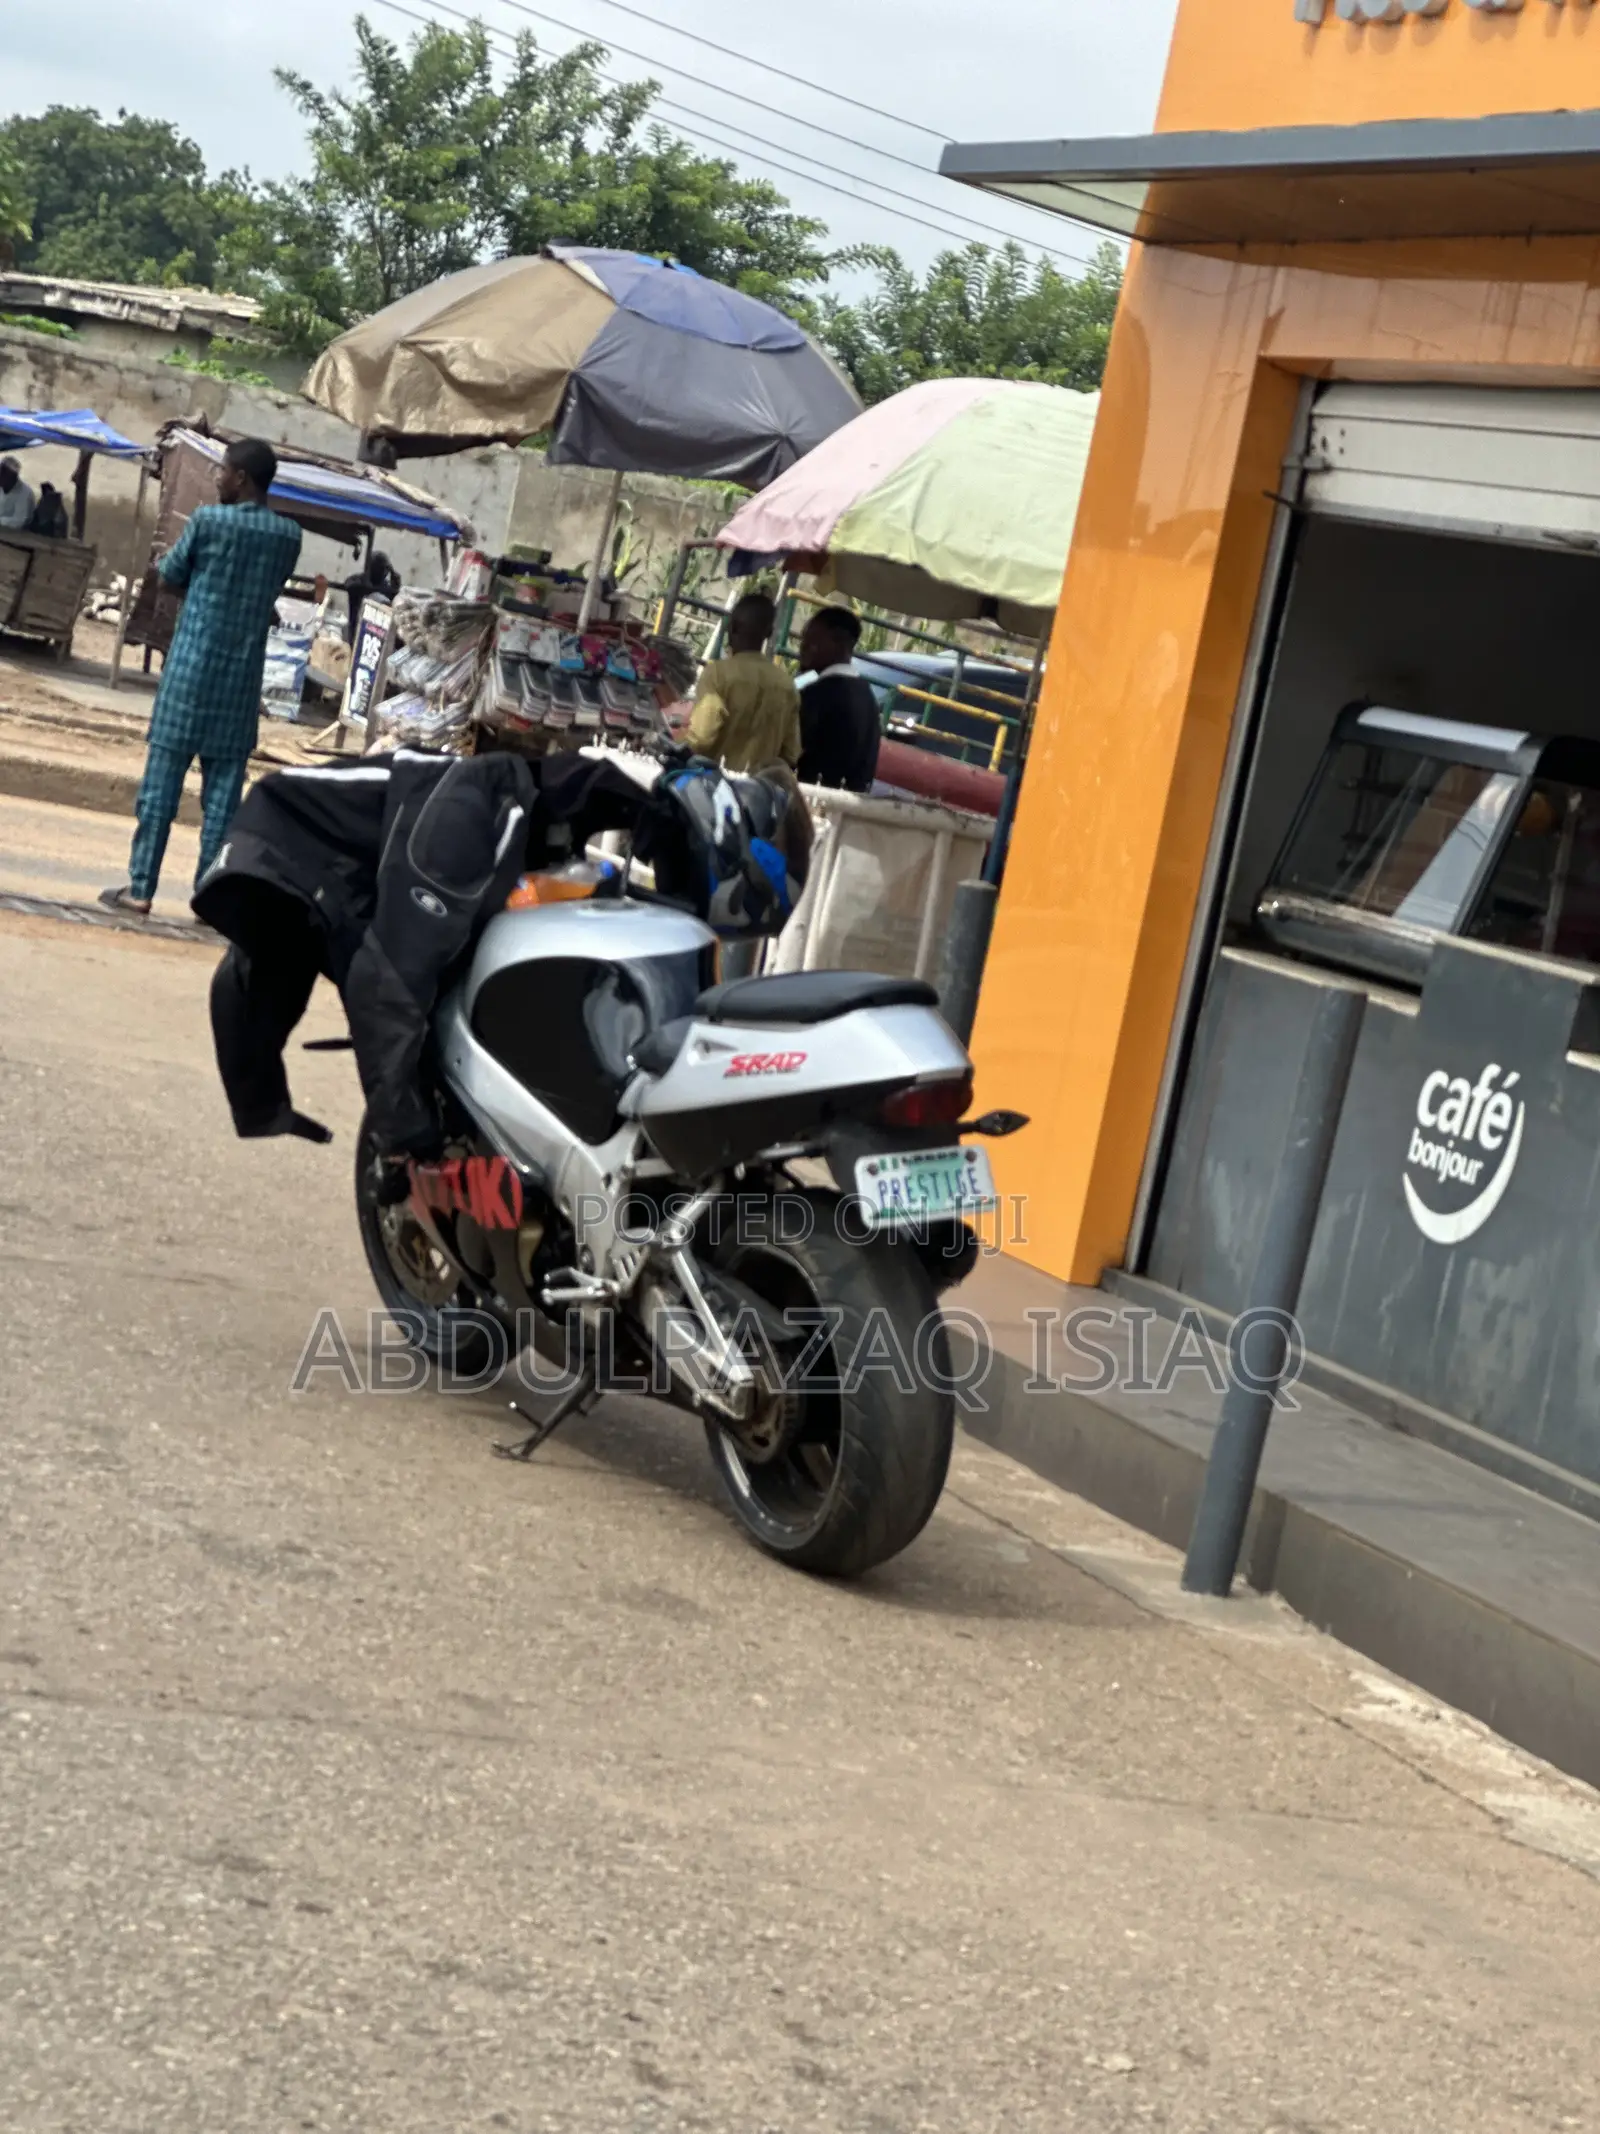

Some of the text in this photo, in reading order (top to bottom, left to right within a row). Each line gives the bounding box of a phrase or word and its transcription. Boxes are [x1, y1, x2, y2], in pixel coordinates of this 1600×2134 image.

[725, 1051, 808, 1073] SRAD
[1416, 1062, 1520, 1151] café
[1407, 1127, 1484, 1186] bonjour
[877, 1167, 982, 1210] PRESTIGE
